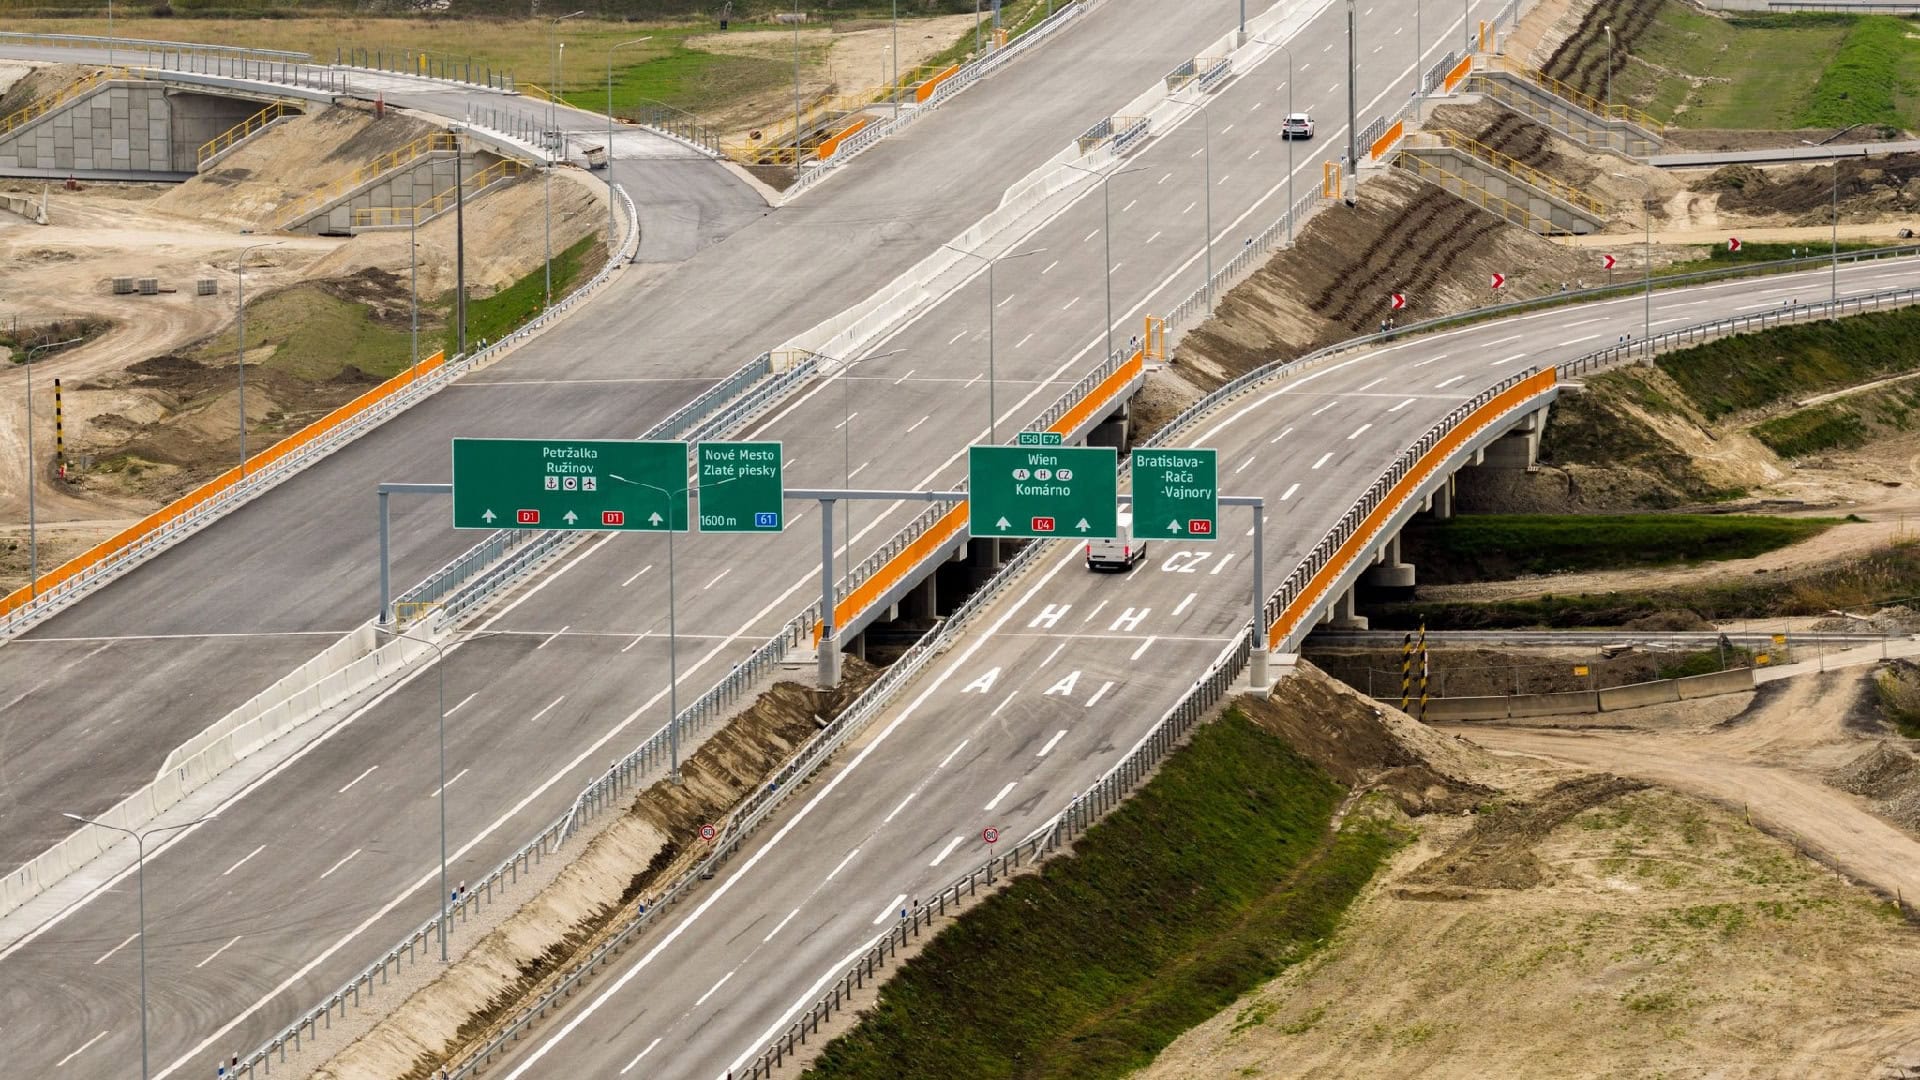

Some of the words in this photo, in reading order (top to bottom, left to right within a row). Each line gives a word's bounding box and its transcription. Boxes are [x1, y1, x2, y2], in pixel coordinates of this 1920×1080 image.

[1021, 435, 1038, 444] E58
[1043, 435, 1059, 444] E75
[543, 447, 598, 459] Petržalka
[705, 449, 735, 461] Nové
[739, 450, 775, 461] Mesto
[1028, 454, 1057, 466] Wien
[1137, 455, 1203, 468] Bratislava-
[546, 462, 594, 474] Ružinov
[704, 464, 735, 476] Zlaté
[738, 465, 776, 478] piesky
[1018, 470, 1025, 479] A
[1040, 470, 1046, 478] H
[1059, 470, 1070, 479] CZ
[1161, 471, 1193, 482] -Rača
[1016, 484, 1070, 496] Komárno
[1161, 487, 1212, 499] -Vajnory
[523, 512, 534, 521] D1
[608, 513, 619, 522] D1
[701, 515, 724, 526] 1600
[761, 515, 772, 525] 61
[1037, 519, 1049, 530] D4
[1194, 522, 1206, 531] D4
[1161, 551, 1212, 573] CZ
[1028, 604, 1072, 628] H
[1108, 607, 1152, 632] H
[960, 666, 1002, 694] A
[1043, 670, 1082, 696] A
